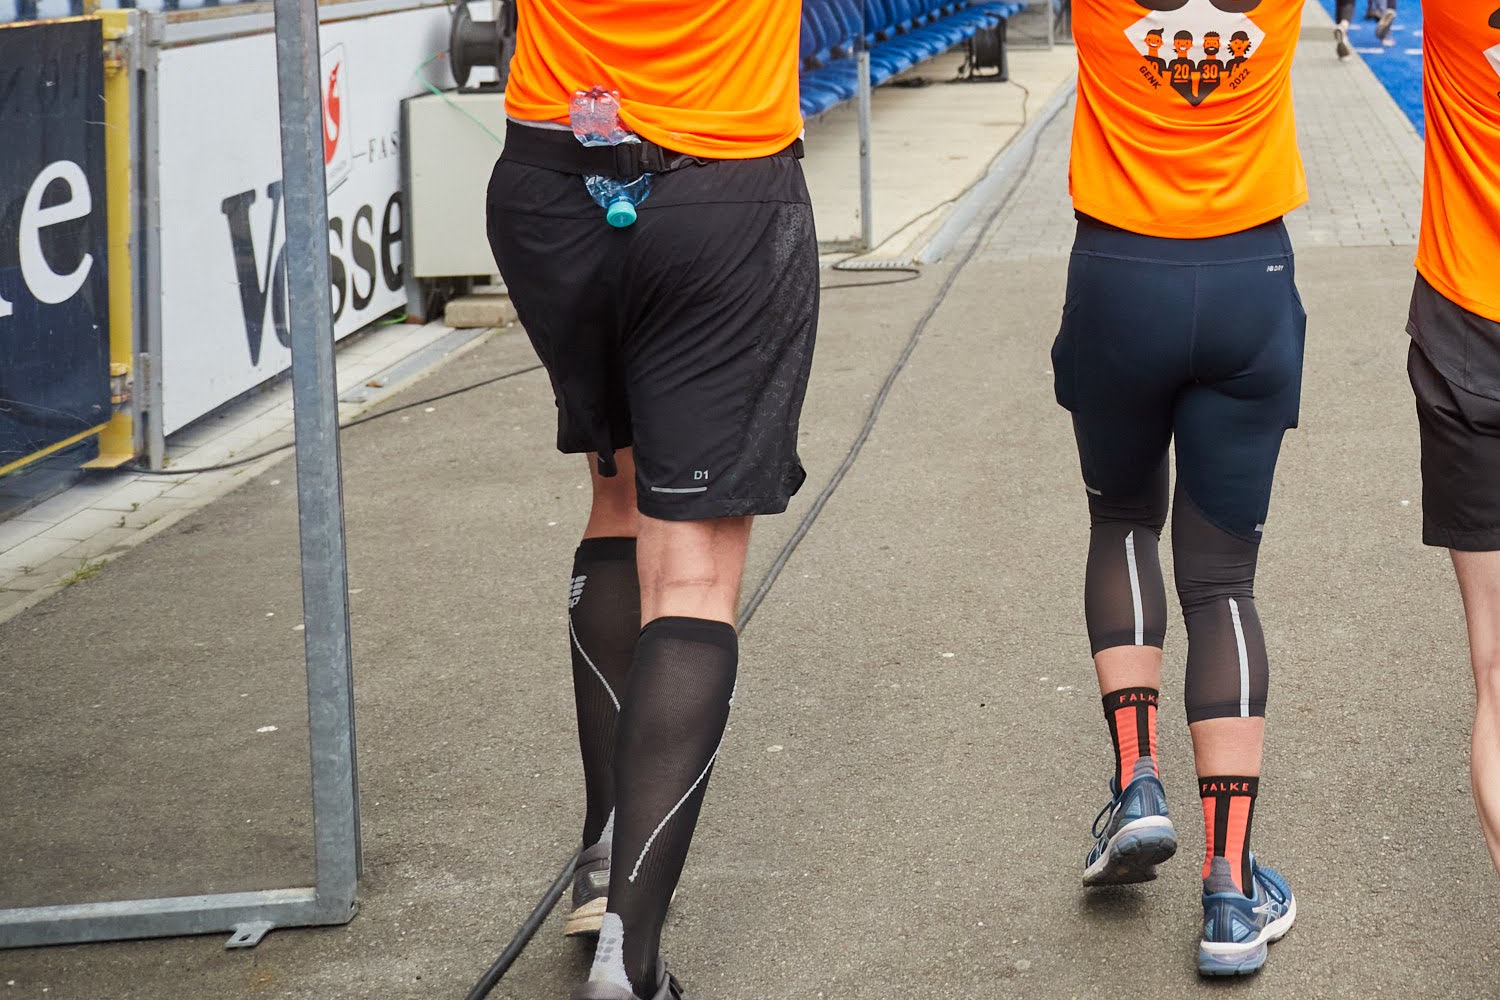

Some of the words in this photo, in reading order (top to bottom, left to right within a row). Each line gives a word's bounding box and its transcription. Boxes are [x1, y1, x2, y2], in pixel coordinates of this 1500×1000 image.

[1138, 64, 1162, 90] GENK
[1173, 63, 1190, 80] 20
[1202, 64, 1218, 80] 30
[1229, 67, 1251, 90] 2022
[0, 159, 94, 316] e
[694, 470, 709, 480] D1
[1202, 782, 1250, 793] FALKE
